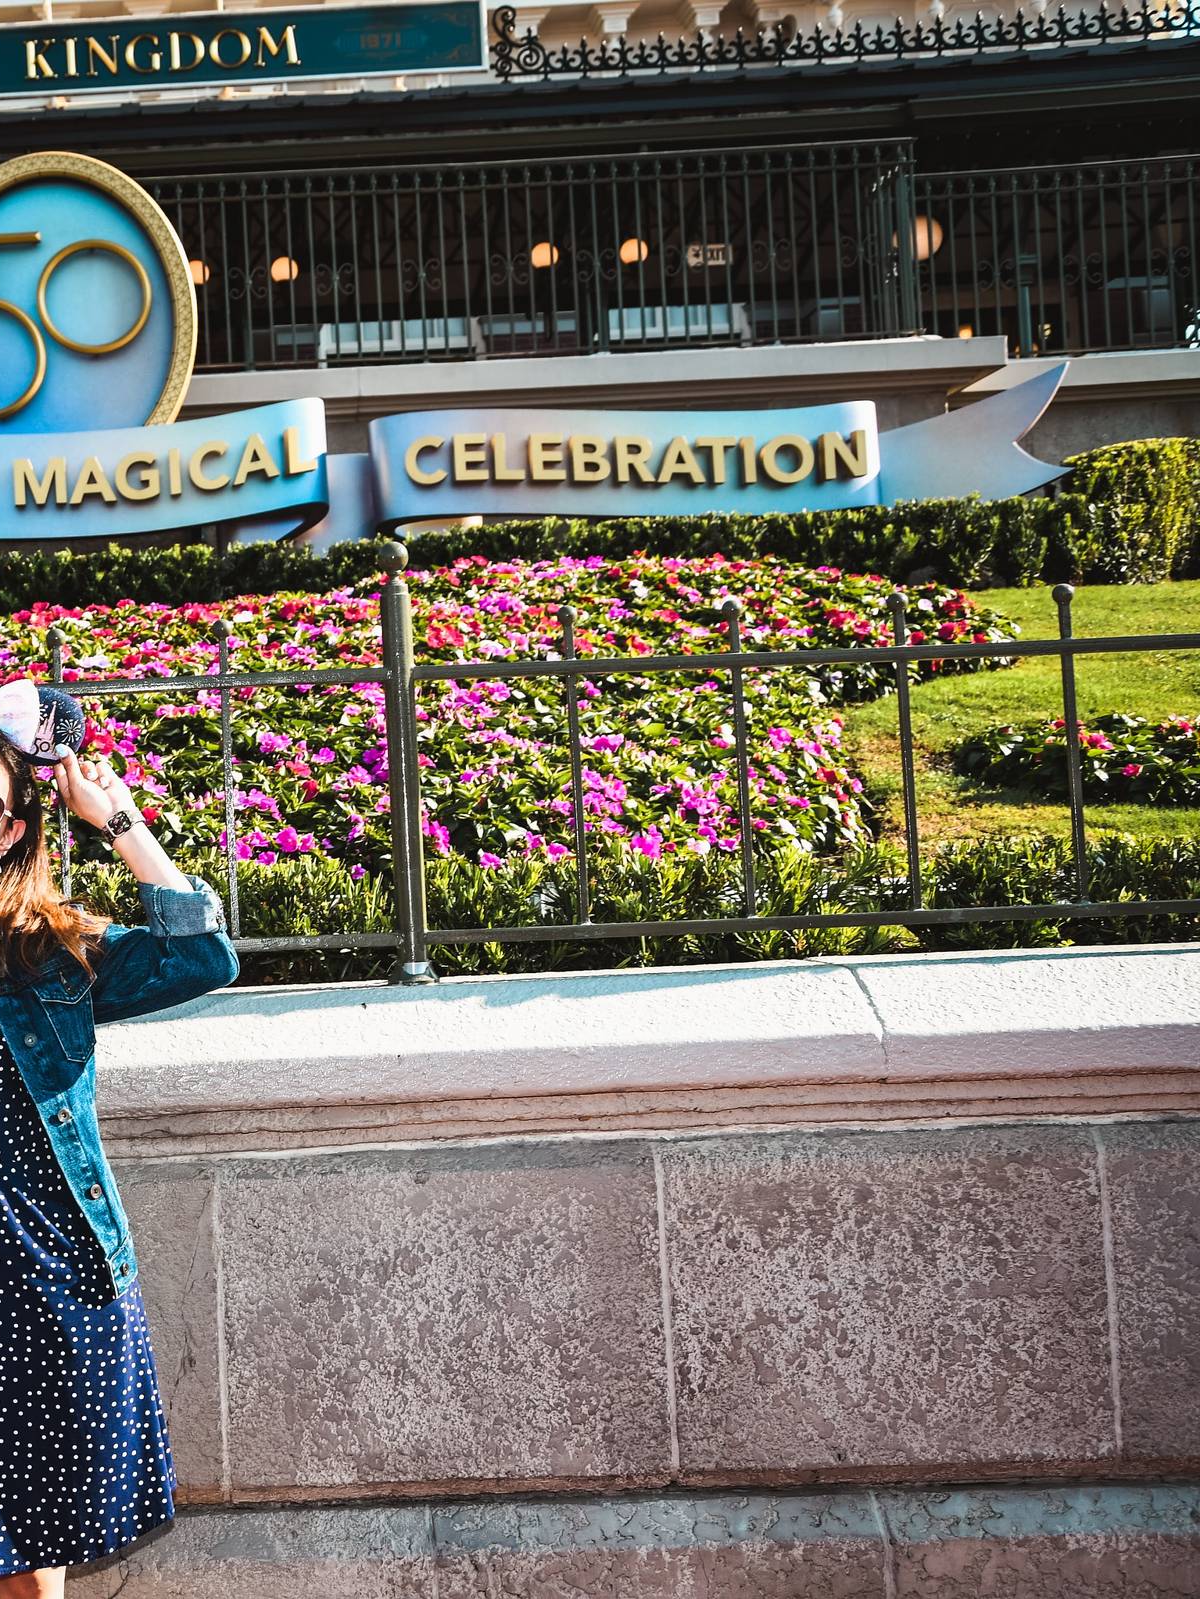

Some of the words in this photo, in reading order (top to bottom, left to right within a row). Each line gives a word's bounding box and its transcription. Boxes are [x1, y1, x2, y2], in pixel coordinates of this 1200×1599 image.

[24, 24, 301, 80] KINGDOM
[13, 426, 319, 507] MAGICAL
[404, 430, 867, 485] CELEBRATION
[31, 738, 50, 755] 50
